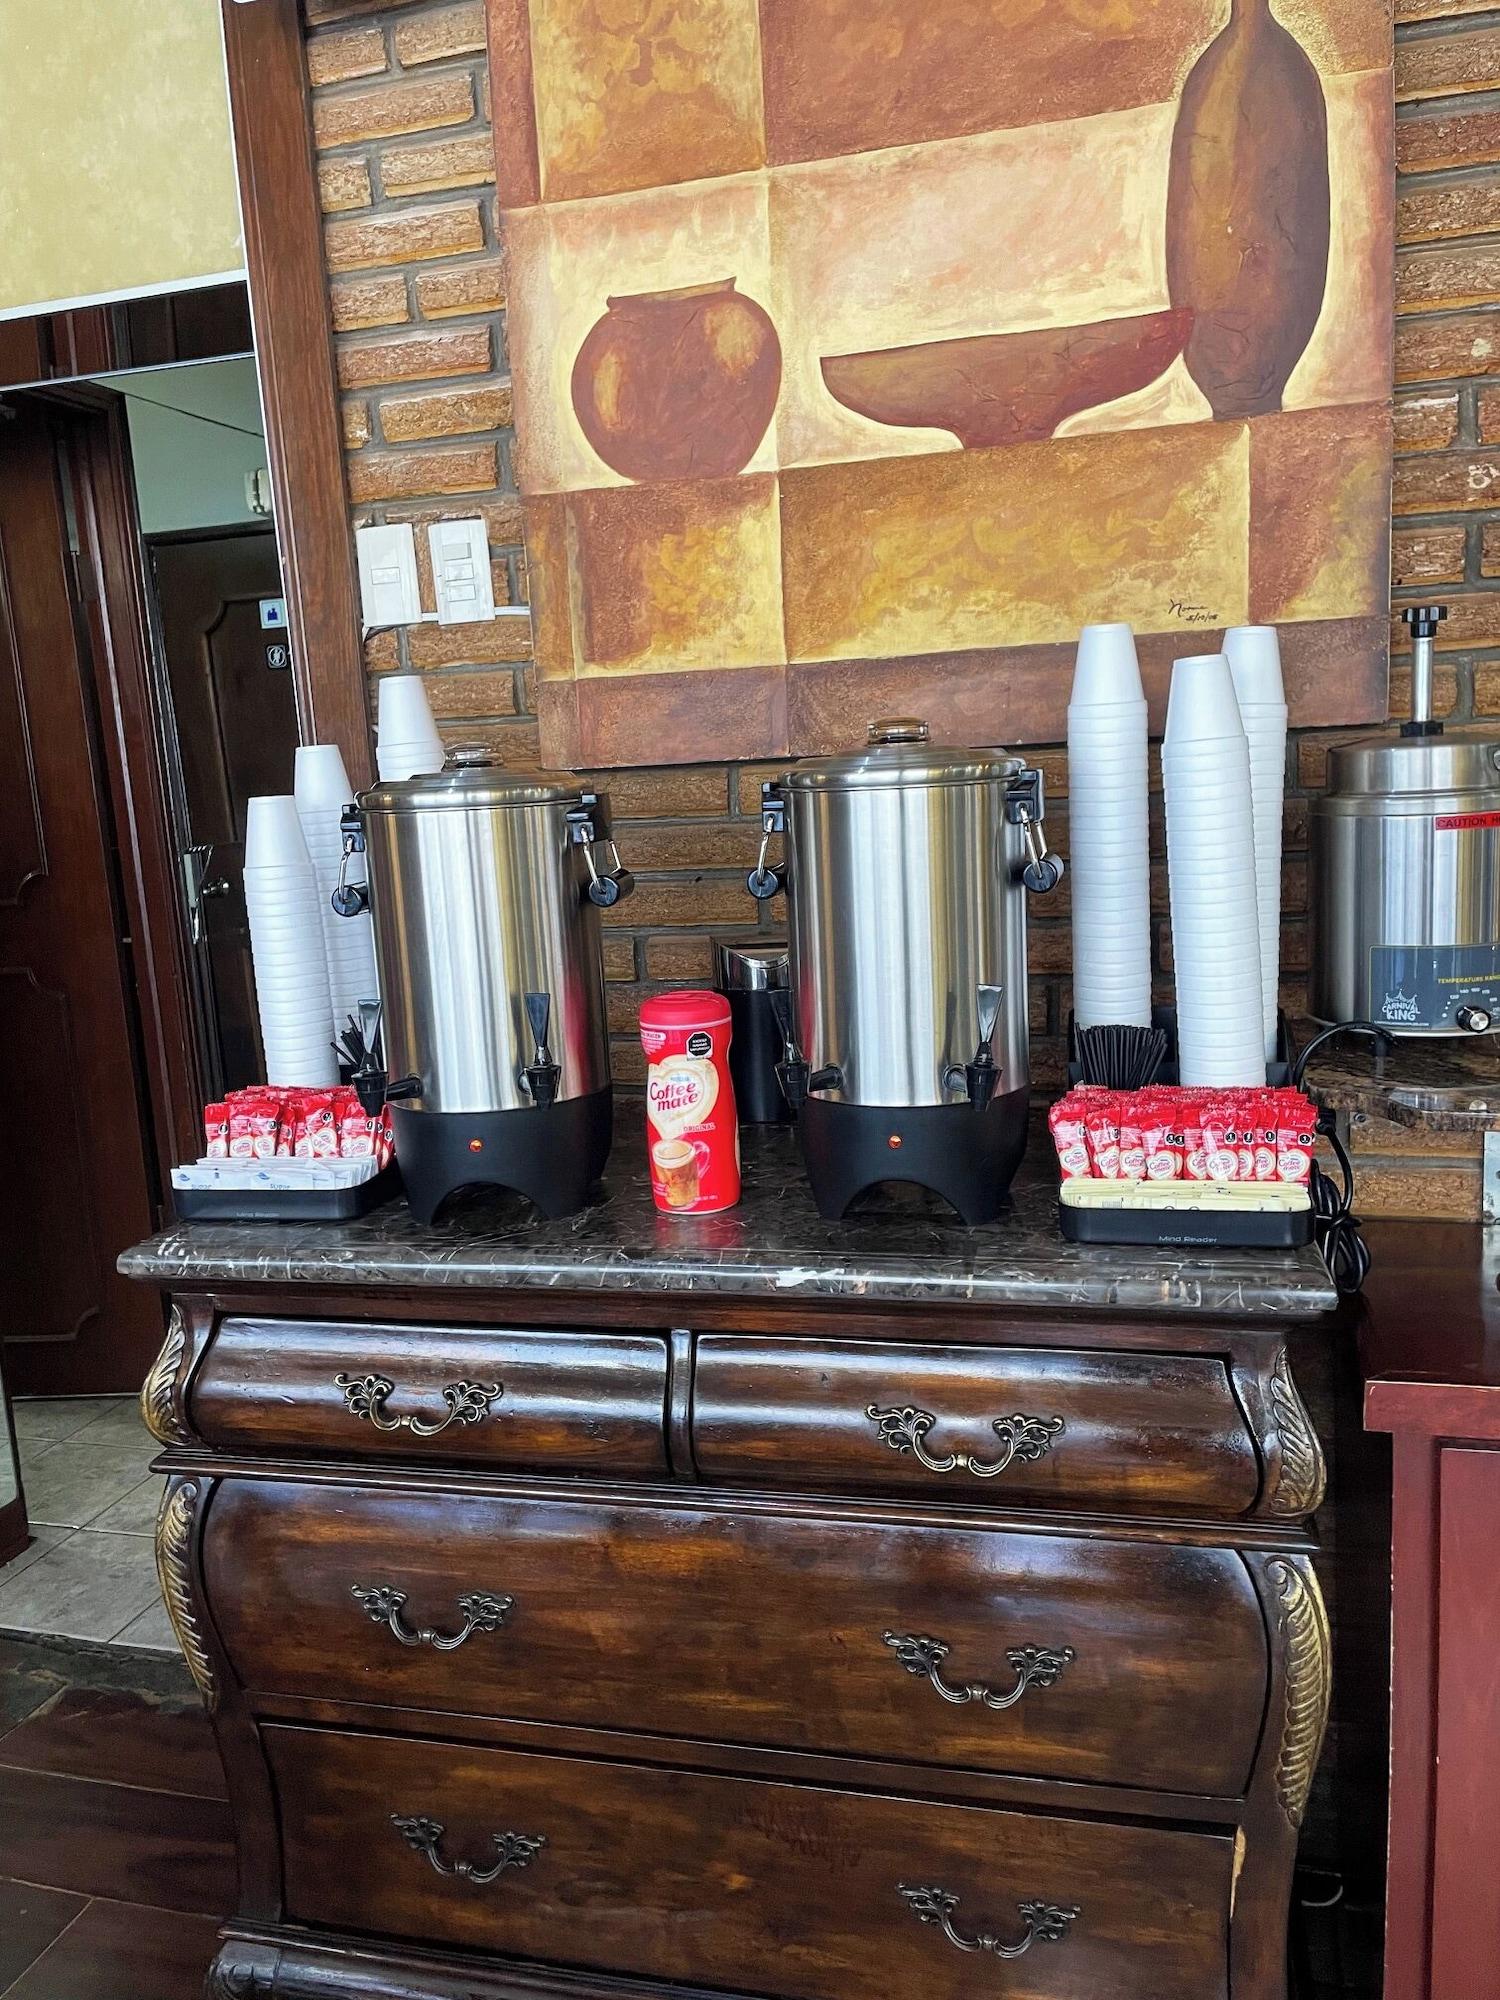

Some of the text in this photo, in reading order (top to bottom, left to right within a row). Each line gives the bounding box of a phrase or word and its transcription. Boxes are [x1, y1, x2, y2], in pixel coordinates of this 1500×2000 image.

[1437, 816, 1487, 828] CAUTION
[1438, 976, 1484, 984] TEMPERATURE
[1382, 1001, 1421, 1014] CARNIVAL
[1386, 1009, 1416, 1021] KING
[650, 1082, 696, 1101] Coffee
[657, 1093, 698, 1112] mate
[683, 1123, 715, 1132] ORIGINAL
